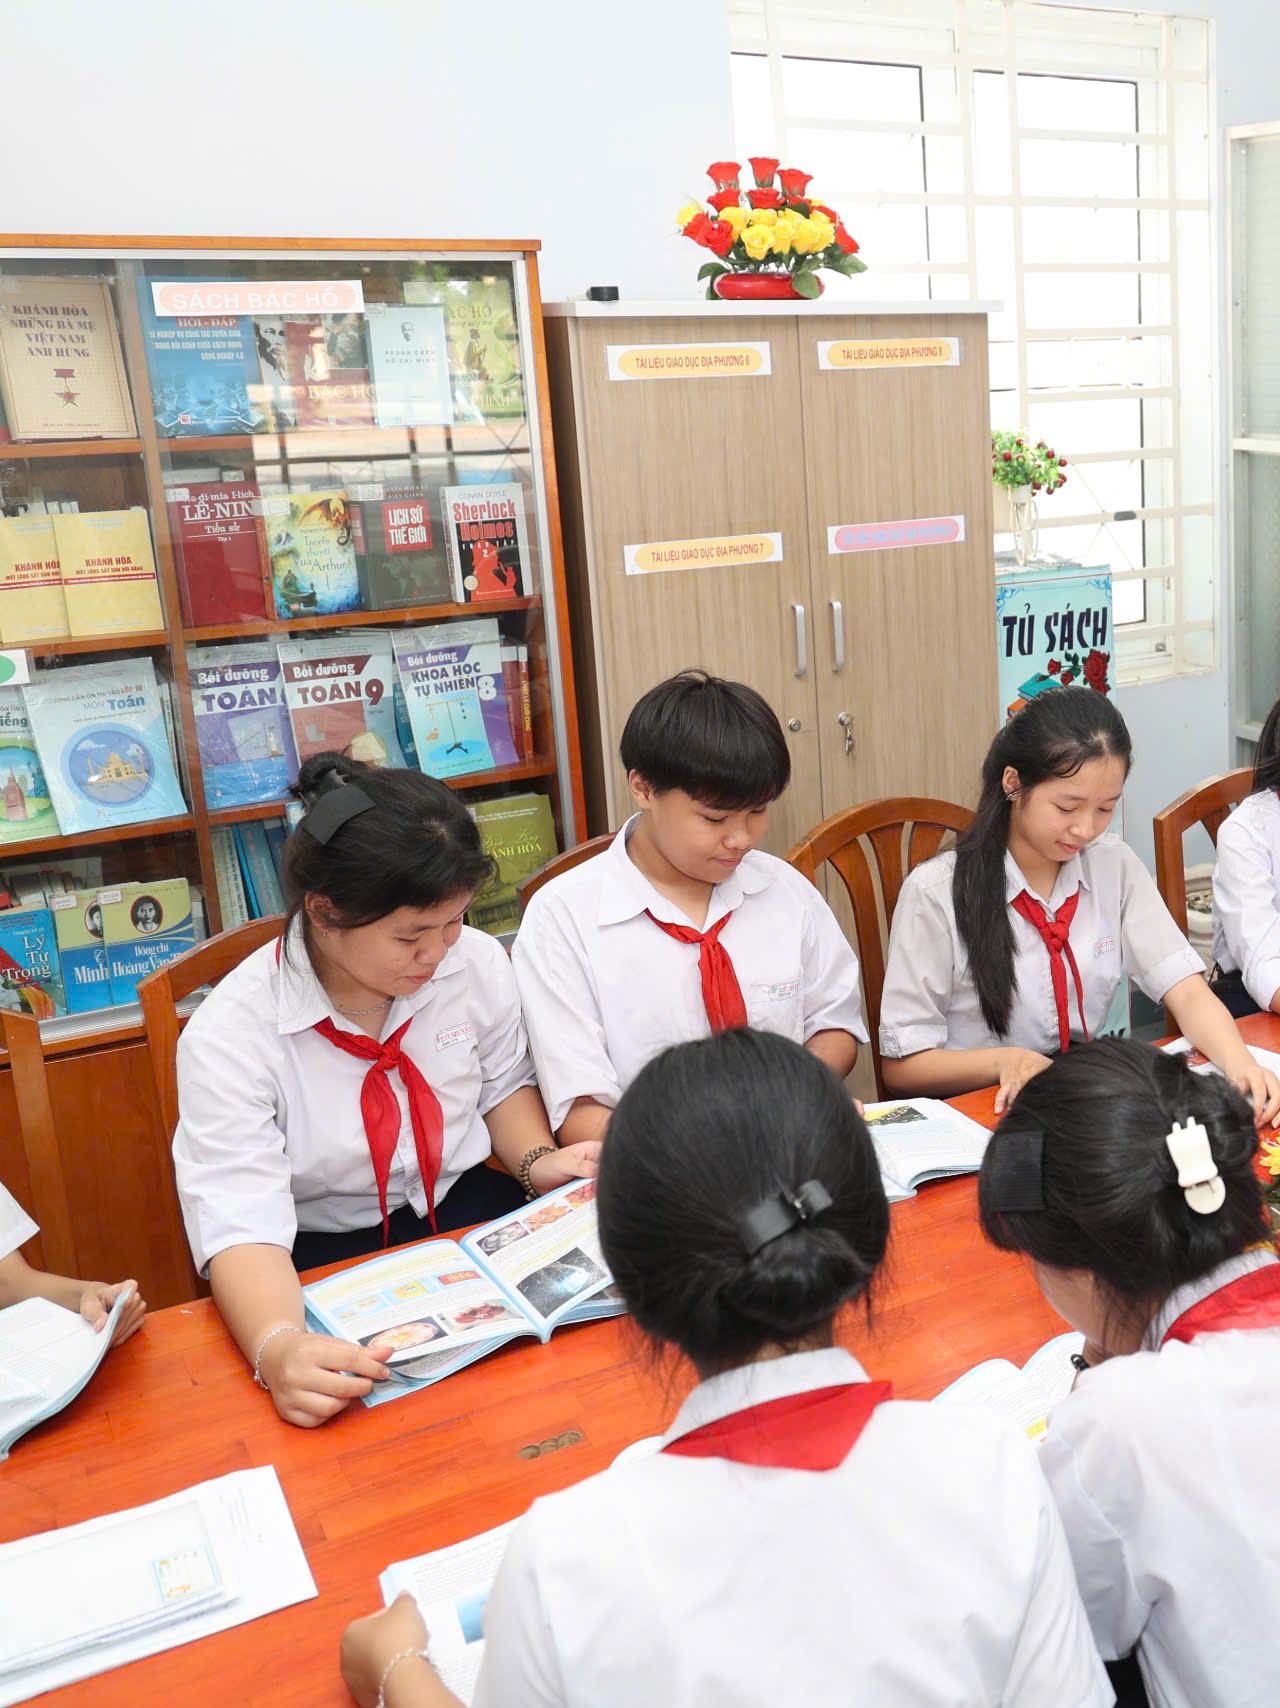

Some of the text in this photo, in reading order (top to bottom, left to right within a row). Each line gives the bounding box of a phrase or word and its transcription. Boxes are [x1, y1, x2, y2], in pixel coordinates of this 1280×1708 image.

[171, 285, 339, 310] SÁCH BÁC HỒ
[13, 304, 89, 317] KHÁNH HÒA
[178, 316, 202, 328] HỎI
[211, 315, 237, 328] ĐÁP
[26, 331, 86, 345] VIỆT NAM
[56, 346, 90, 358] HÙNG
[666, 353, 684, 368] GIÁO
[685, 355, 700, 371] DỤC
[701, 354, 714, 370] ĐỊA
[714, 353, 744, 367] PHƯƠNG
[745, 354, 751, 366] 6
[182, 500, 254, 521] LÊ-NIN
[388, 505, 424, 528] LỊCH SỬ
[453, 499, 517, 521] Sherlock
[204, 521, 241, 535] Tiểu sử
[389, 524, 428, 546] THẾ GIỚI
[460, 521, 514, 542] Holmes
[482, 549, 489, 558] 2
[681, 546, 699, 560] GIÁO
[700, 546, 715, 561] DỤC
[716, 545, 728, 560] ĐỊA
[728, 543, 759, 557] PHƯƠNG
[759, 542, 765, 553] 7
[15, 560, 43, 573] KHÁNH
[85, 556, 113, 568] KHÁNH
[1002, 603, 1108, 657] TỦ SÁCH
[293, 660, 356, 679] Bồi dưỡng
[412, 661, 482, 684] KHOA HỌC
[297, 677, 385, 707] TOÁN 9
[414, 674, 498, 702] TỰ NHIÊN 8
[108, 694, 146, 711] Toán
[201, 685, 277, 714] TOÁN
[0, 711, 29, 728] iếng
[24, 933, 46, 951] Lý
[25, 950, 50, 965] Tự
[1, 964, 52, 981] Trọng
[112, 959, 150, 977] Hoàng
